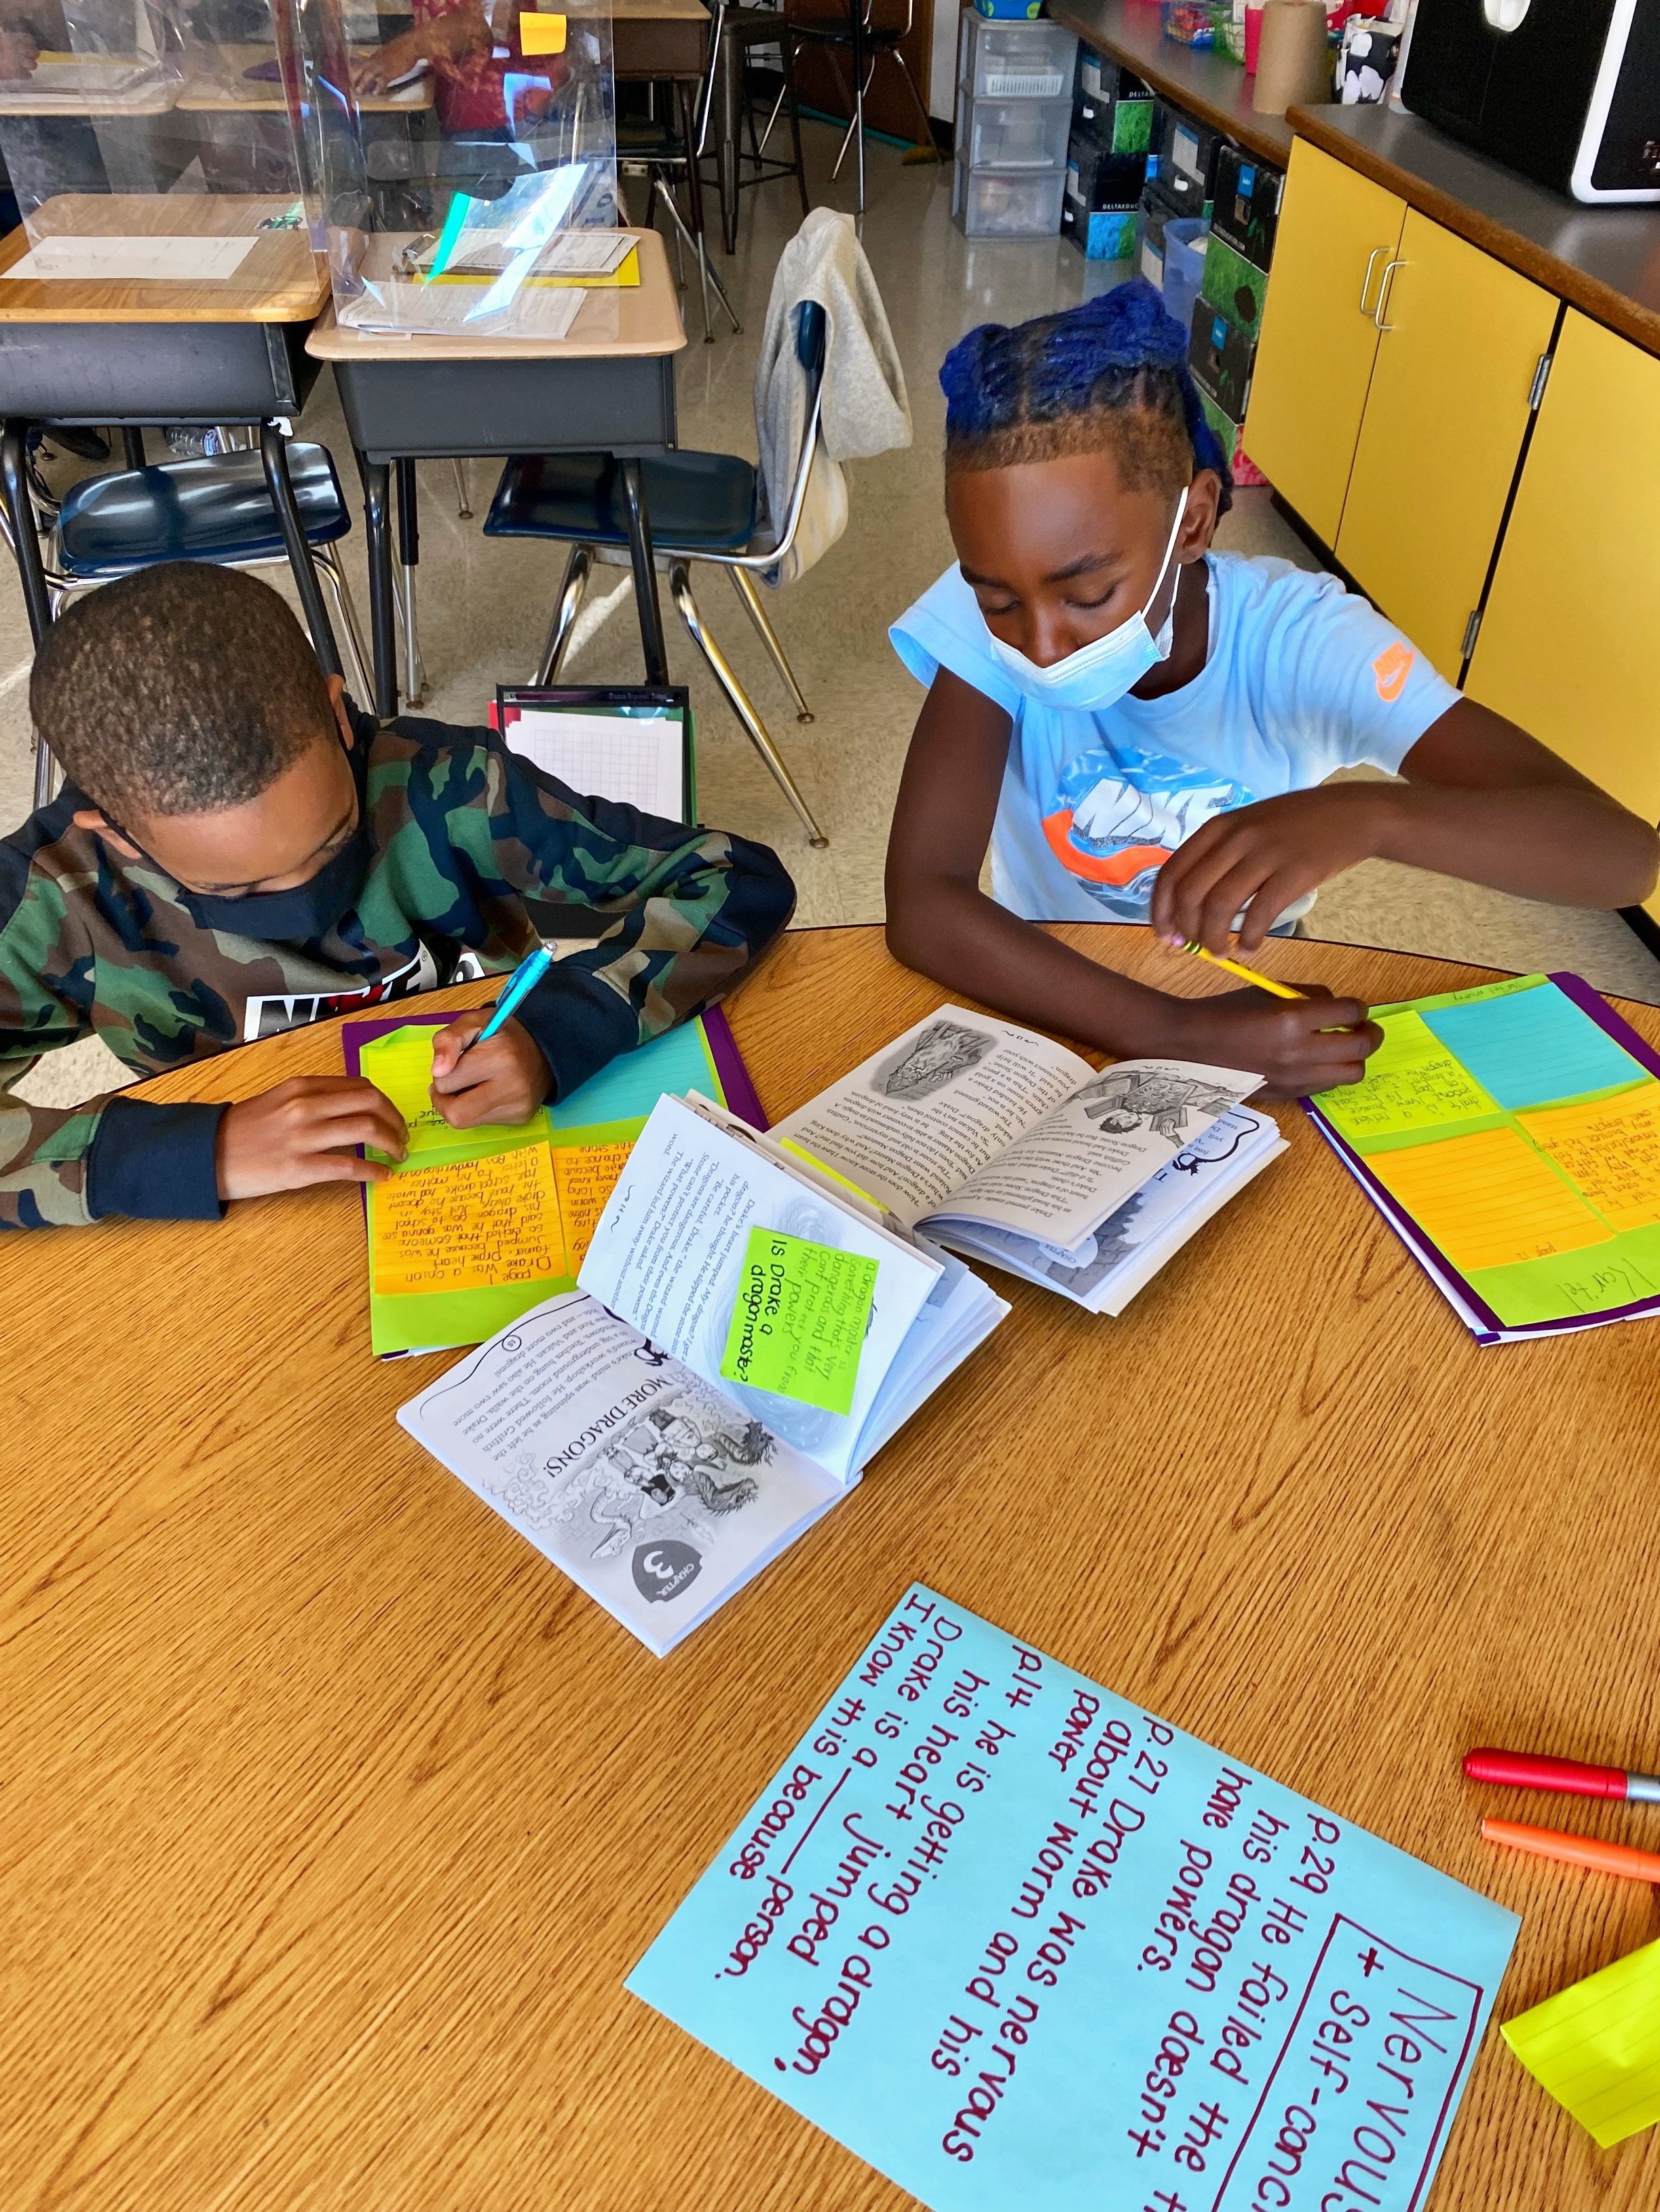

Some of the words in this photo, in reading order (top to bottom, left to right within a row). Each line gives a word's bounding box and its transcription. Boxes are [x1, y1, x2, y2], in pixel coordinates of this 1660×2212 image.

[954, 1090, 979, 1103] grinned
[973, 1080, 993, 1091] Drake
[992, 1090, 1017, 1107] handed
[1006, 1088, 1023, 1100] stone
[939, 1102, 959, 1113] Drake
[977, 1101, 999, 1116] wizard
[1025, 1099, 1043, 1115] green
[1032, 1094, 1049, 1109] chain.
[924, 1113, 948, 1126] control
[948, 1126, 970, 1141] cannot
[958, 1121, 978, 1137] Vulcan
[995, 1124, 1013, 1140] asked.
[1000, 1115, 1012, 1128] The
[991, 1133, 1005, 1147] only
[694, 1152, 709, 1176] Stone
[683, 1177, 696, 1196] can't
[618, 1204, 626, 1213] 14
[668, 1196, 685, 1227] protect
[695, 1194, 714, 1224] careful,
[647, 1221, 662, 1245] Drake
[660, 1226, 671, 1244] you
[771, 1240, 787, 1256] Is
[506, 1257, 551, 1270] Drake
[636, 1245, 649, 1270] asked.
[651, 1244, 664, 1265] from
[673, 1259, 683, 1274] the
[797, 1247, 818, 1278] their
[503, 1268, 531, 1281] page
[643, 1265, 654, 1286] their
[819, 1253, 846, 1313] dangerous
[661, 1276, 675, 1306] wizard
[742, 1265, 766, 1322] dragon
[765, 1264, 785, 1316] Drake
[848, 1274, 874, 1312] dragon
[782, 1278, 801, 1335] powers
[759, 1324, 772, 1335] a
[812, 1316, 829, 1342] and
[845, 1316, 861, 1356] master
[734, 1324, 753, 1381] master?
[787, 1330, 802, 1360] you
[804, 1346, 821, 1373] that
[575, 1379, 590, 1392] was
[591, 1363, 611, 1380] mind
[552, 1384, 566, 1395] He
[622, 1379, 671, 1410] MORE
[515, 1395, 552, 1427] followed
[540, 1392, 575, 1419] spinning
[483, 1426, 515, 1451] Griffith
[507, 1436, 523, 1449] left
[522, 1427, 534, 1436] he
[544, 1406, 628, 1477] DRAGONS!
[493, 1449, 507, 1461] the
[643, 1550, 674, 1579] 3
[656, 1563, 694, 1597] CHAPTER
[904, 1594, 936, 1623] I
[898, 1616, 962, 1701] Drake
[943, 1670, 989, 1717] his
[814, 1698, 866, 1756] this
[875, 1711, 908, 1738] is
[975, 1720, 1016, 1755] he
[1049, 1690, 1099, 1772] power
[852, 1748, 878, 1768] a
[1069, 1720, 1131, 1818] about
[1129, 1716, 1173, 1794] p.27
[886, 1725, 959, 1820] heart
[956, 1762, 991, 1792] is
[1203, 1767, 1252, 1828] have
[730, 1765, 823, 1880] because
[1243, 1810, 1289, 1863] his
[867, 1795, 962, 1915] getting
[1072, 1799, 1145, 1898] Drake
[1289, 1814, 1340, 1894] p.29
[1011, 1822, 1078, 1918] worm
[787, 1813, 890, 1966] jumped
[1137, 1839, 1212, 1971] powers.
[715, 1875, 793, 1979] person.
[1180, 1873, 1260, 1991] dragon
[1262, 1898, 1307, 1944] He
[858, 1926, 890, 1949] a
[1027, 1911, 1086, 1986] was
[965, 1932, 1018, 2008] and
[774, 1956, 872, 2074] dragon,
[1210, 1962, 1288, 2084] failed
[932, 2015, 983, 2076] his
[943, 1996, 1038, 2162] nervous
[1128, 2011, 1204, 2158] doesn't
[1251, 1990, 1370, 2212] Self-conc
[1174, 2102, 1228, 2172] the
